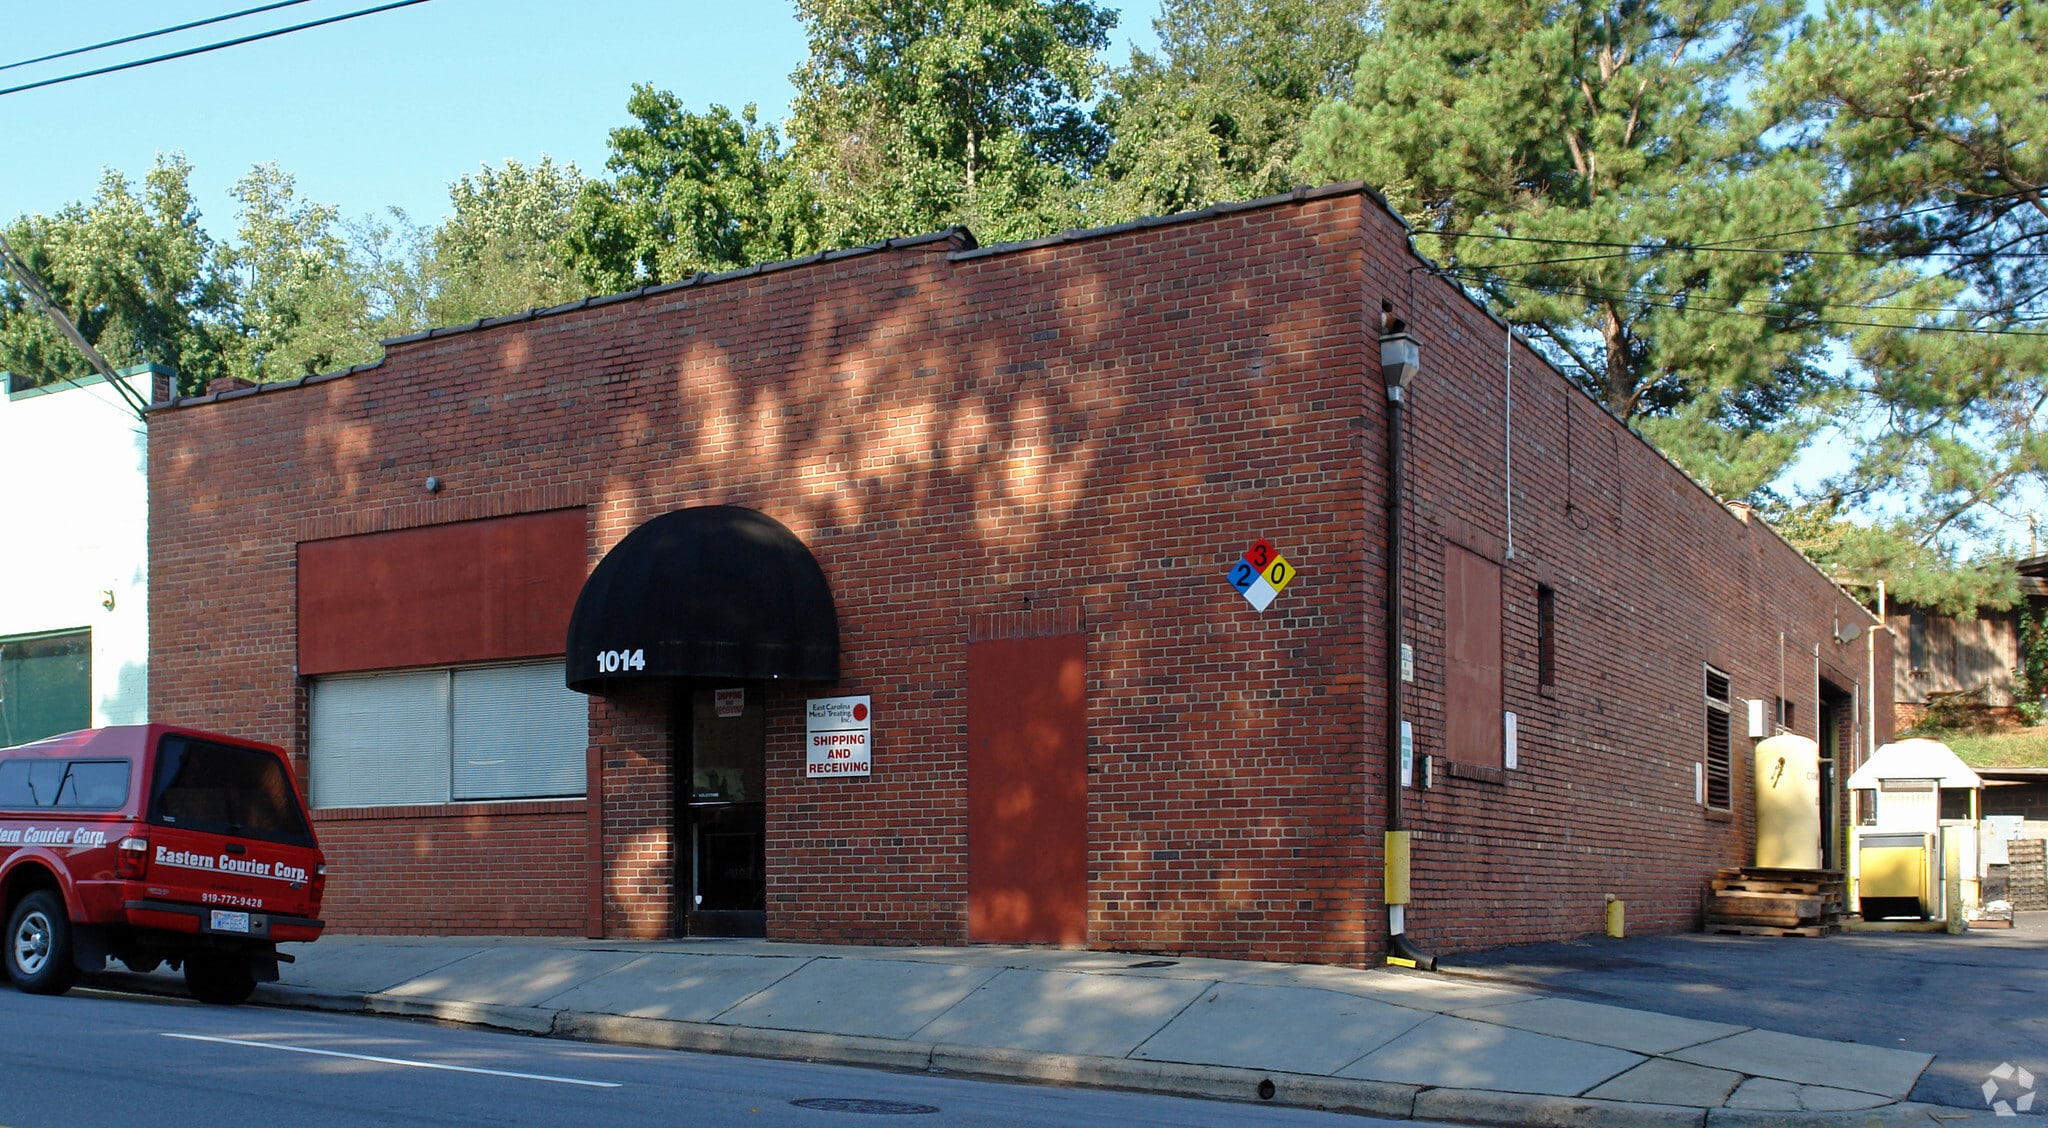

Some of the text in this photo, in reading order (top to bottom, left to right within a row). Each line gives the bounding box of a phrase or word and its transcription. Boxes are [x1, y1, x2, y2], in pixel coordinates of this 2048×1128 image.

[1254, 544, 1267, 567] 3
[1236, 564, 1251, 586] 2
[1271, 563, 1285, 584] 0
[597, 649, 646, 673] 1014
[812, 703, 825, 711] East
[813, 734, 865, 746] SHIPPING
[827, 749, 851, 759] AND
[809, 762, 869, 773] RECEIVING
[24, 827, 71, 844] Courier
[73, 827, 107, 848] Corp.
[155, 845, 309, 882] Eastern Courier Corp.
[202, 892, 263, 908] 919-772-9428
